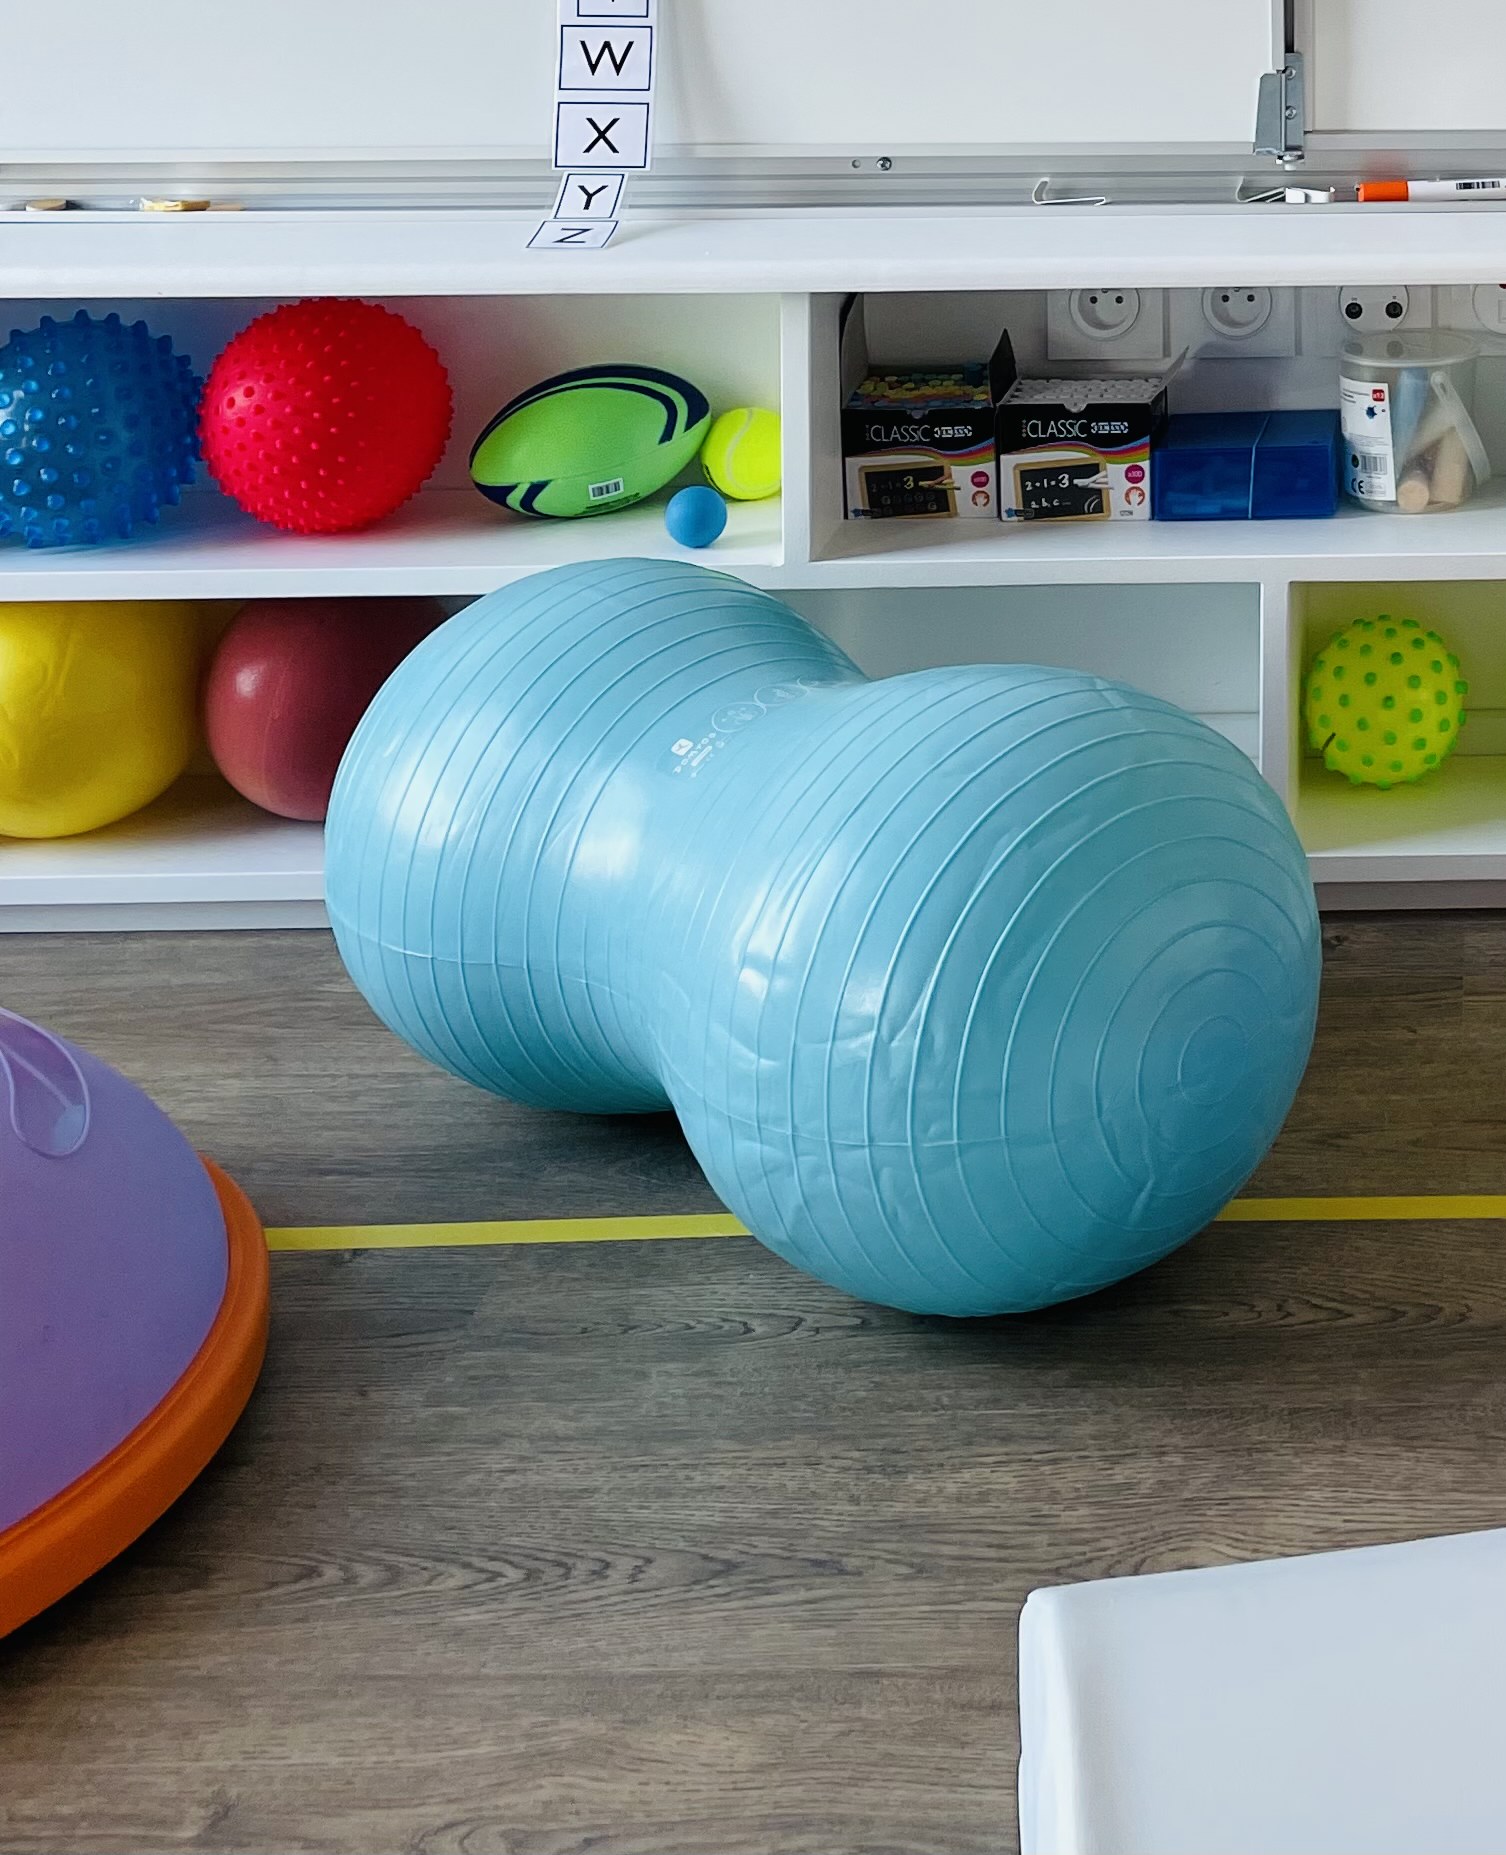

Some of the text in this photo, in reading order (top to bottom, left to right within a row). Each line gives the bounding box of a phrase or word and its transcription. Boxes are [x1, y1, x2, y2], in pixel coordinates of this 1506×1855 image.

[579, 40, 635, 77] W
[582, 117, 620, 154] X
[577, 185, 608, 211] Y
[552, 226, 595, 244] Z
